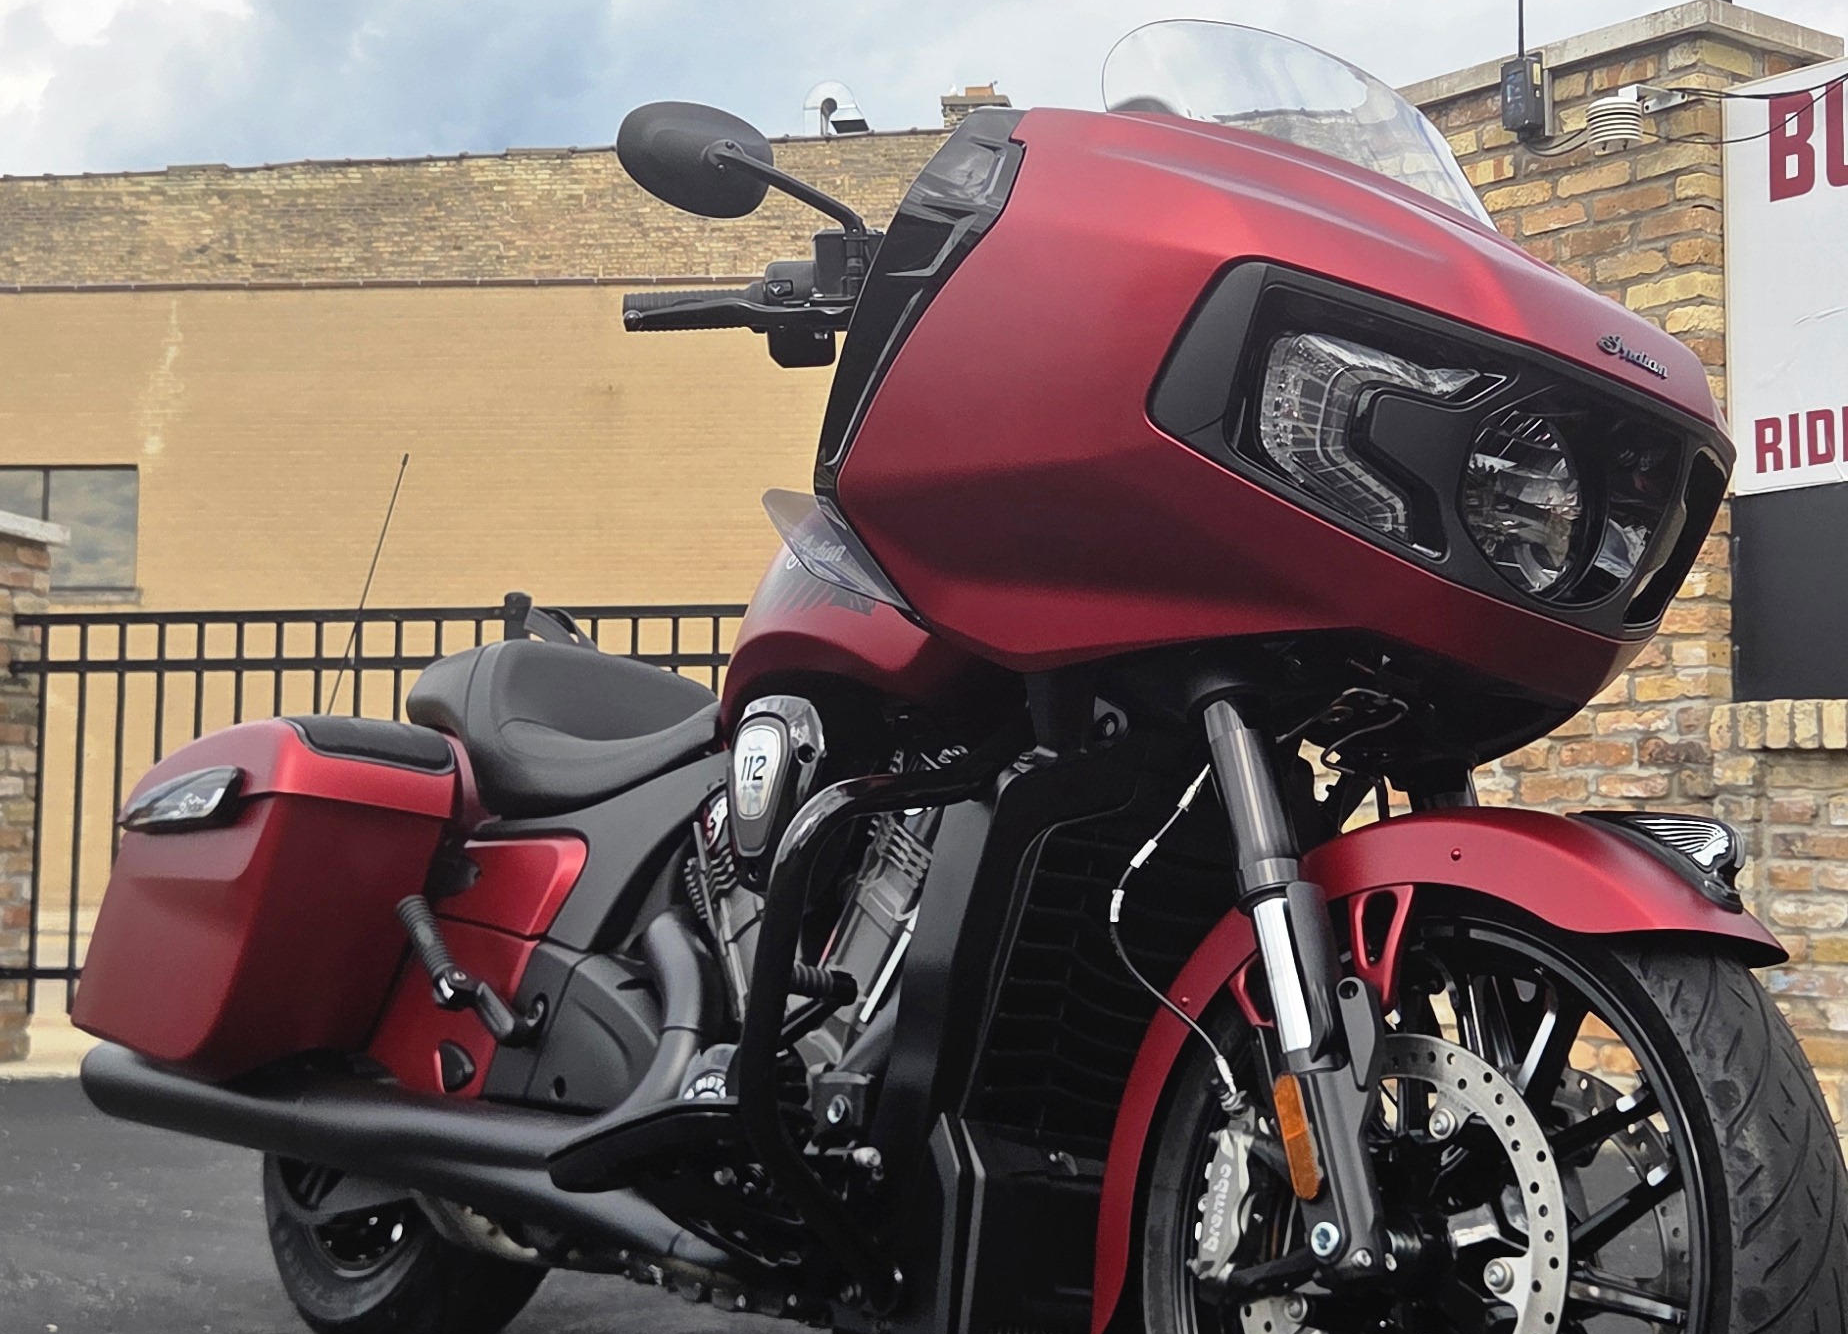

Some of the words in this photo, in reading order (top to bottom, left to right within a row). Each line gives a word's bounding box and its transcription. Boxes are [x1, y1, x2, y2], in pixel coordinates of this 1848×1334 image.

[1596, 334, 1668, 380] Indian
[741, 755, 767, 782] 112
[1202, 1163, 1232, 1252] brembo
